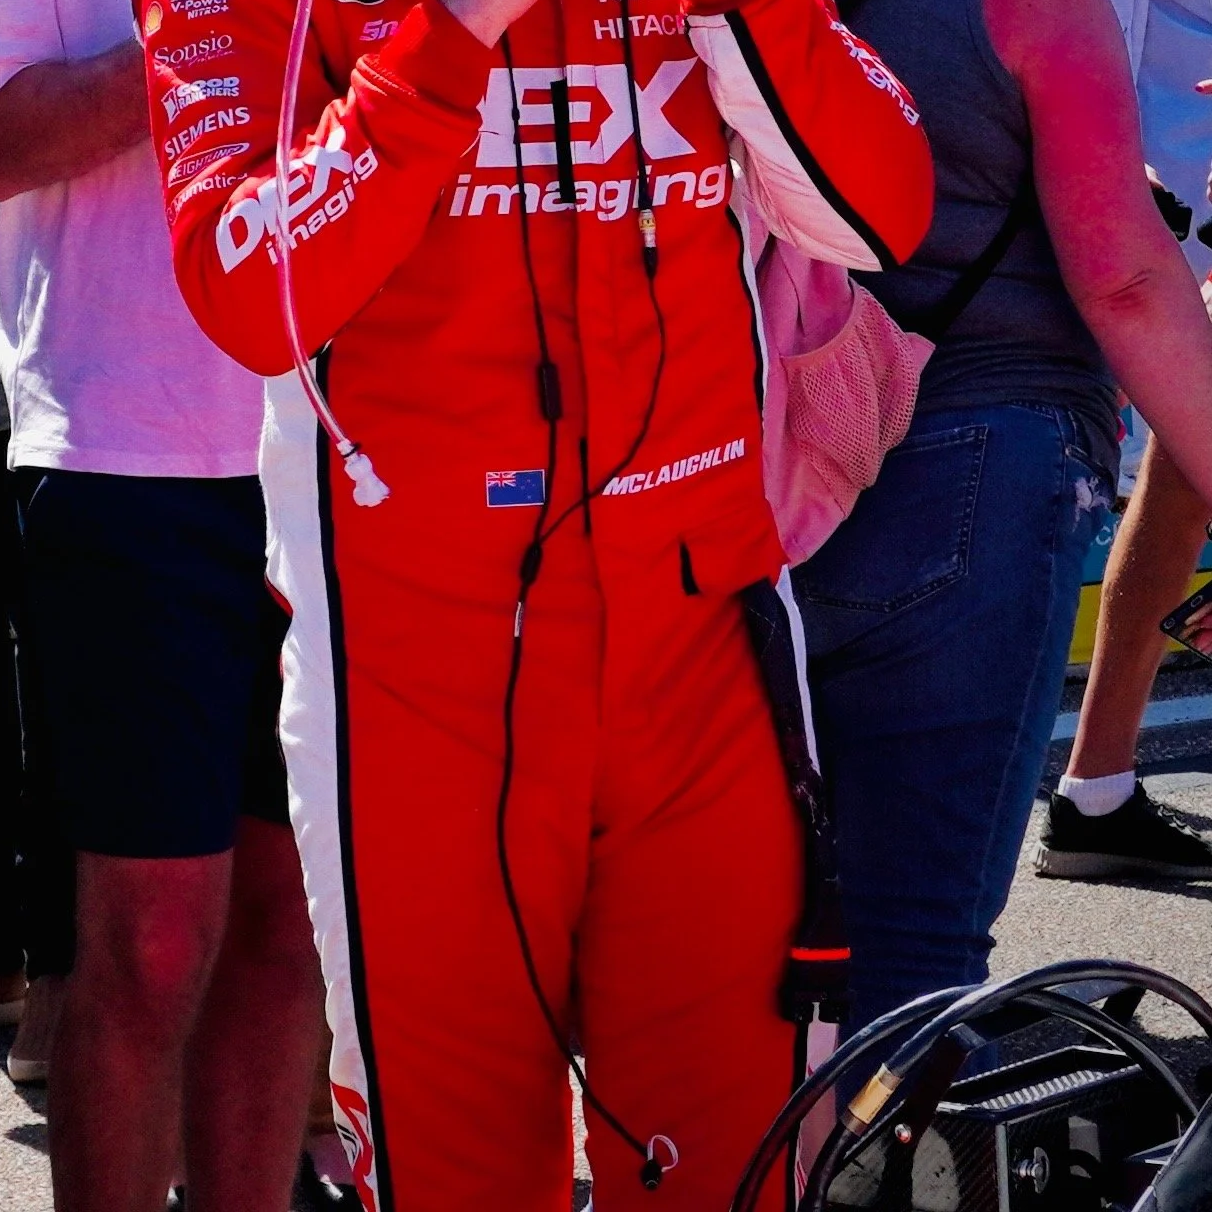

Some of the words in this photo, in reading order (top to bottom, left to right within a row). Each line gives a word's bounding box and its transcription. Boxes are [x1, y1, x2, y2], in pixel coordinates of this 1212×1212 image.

[154, 30, 233, 65] Sonsio
[177, 77, 240, 98] GOOD
[177, 87, 240, 110] RANCHERS
[476, 56, 698, 168] EX
[164, 106, 250, 160] SIEMENS
[215, 126, 354, 275] DEX
[449, 163, 728, 222] imaging
[602, 437, 746, 497] MCLAUGHLIN
